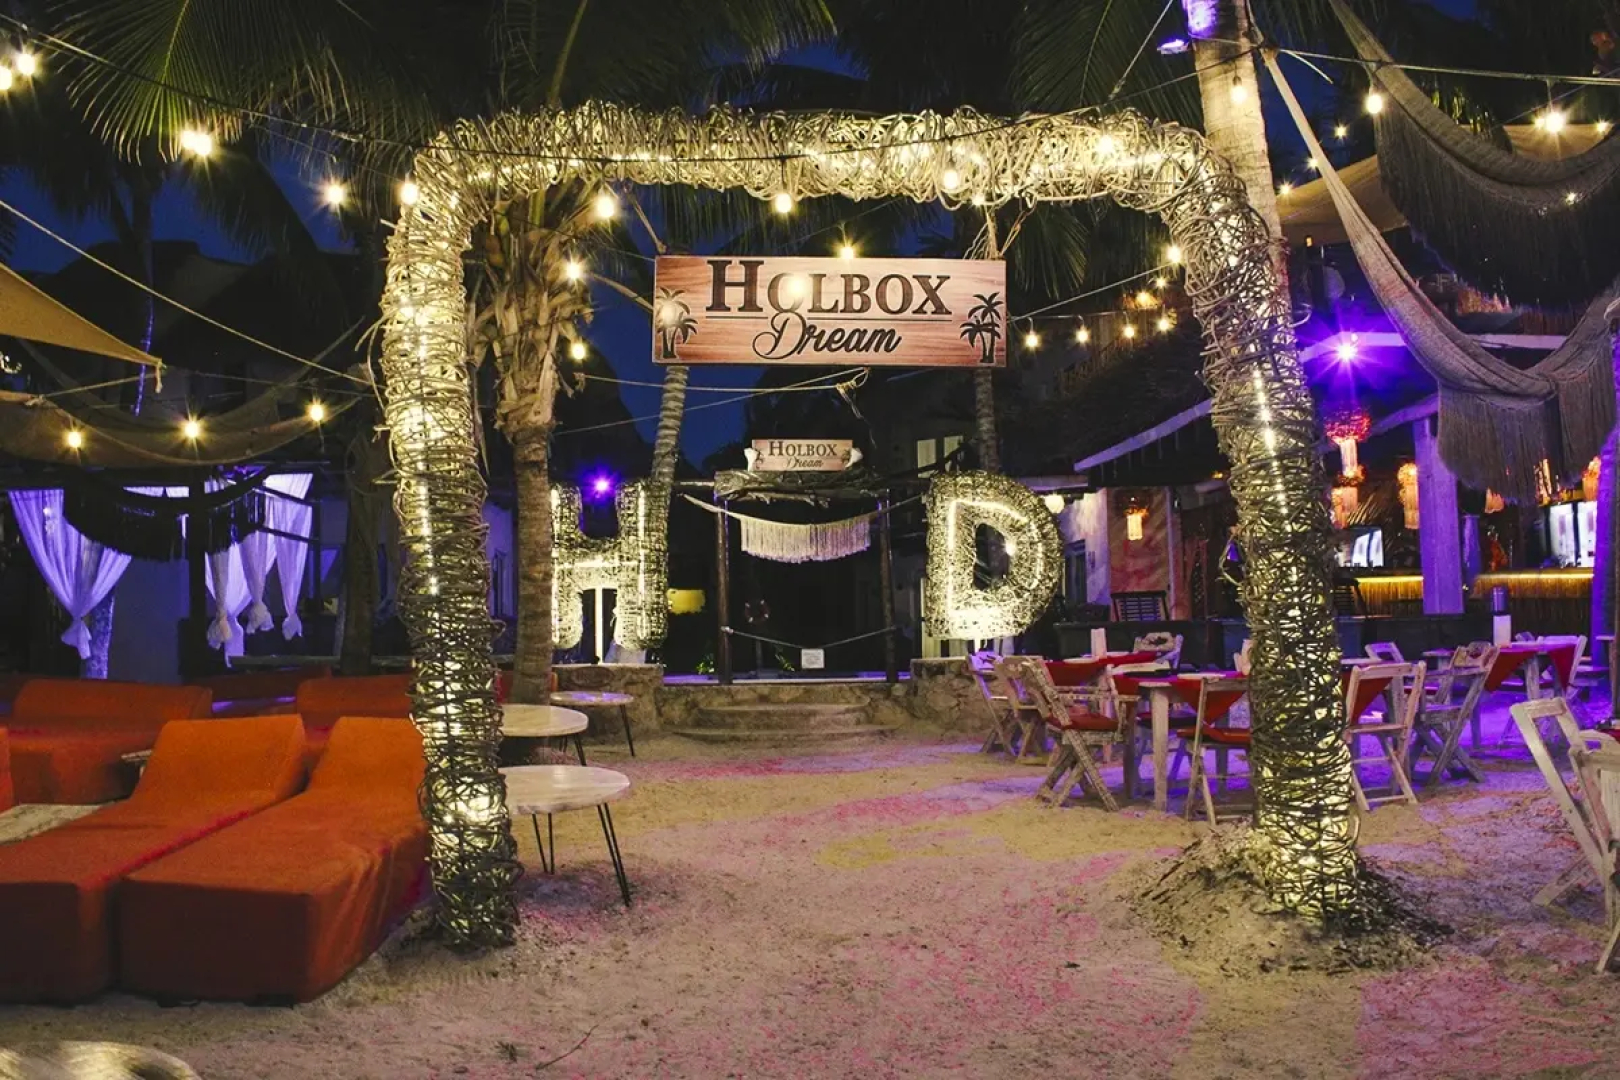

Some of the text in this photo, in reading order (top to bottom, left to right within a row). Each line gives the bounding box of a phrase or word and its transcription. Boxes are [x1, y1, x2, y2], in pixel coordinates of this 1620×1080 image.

[706, 260, 952, 315] HOLBOX
[753, 312, 902, 360] Dream
[768, 440, 838, 457] HOLBOX
[786, 456, 824, 469] Dream
[924, 470, 1064, 640] D
